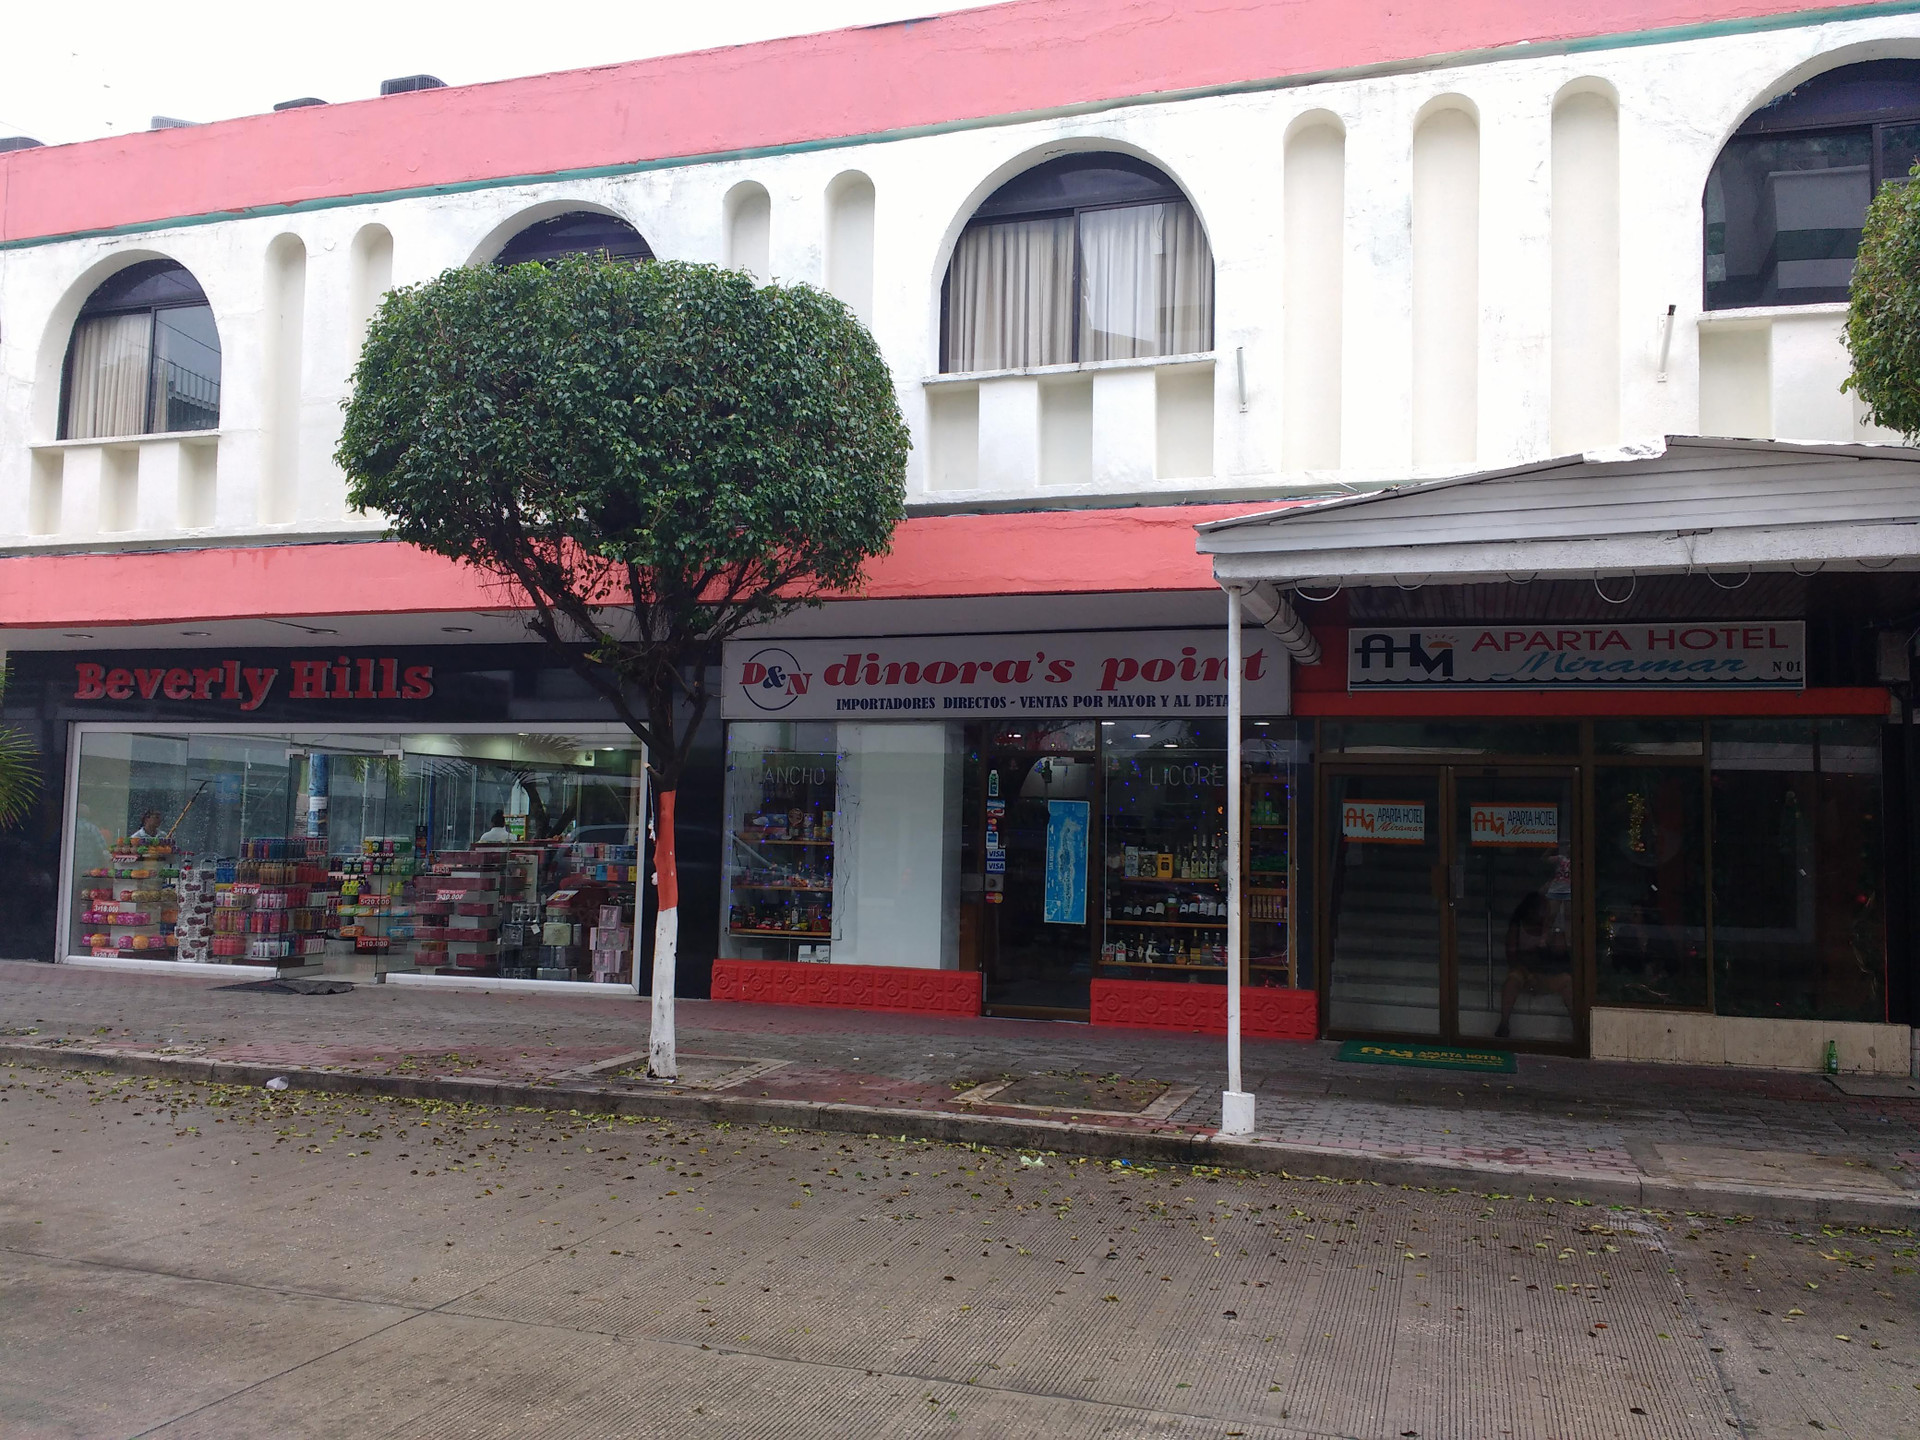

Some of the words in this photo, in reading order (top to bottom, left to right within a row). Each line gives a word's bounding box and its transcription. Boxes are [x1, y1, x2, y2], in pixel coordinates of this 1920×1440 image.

[1472, 630, 1632, 652] APARTA
[1648, 627, 1788, 650] HOTEL
[823, 652, 1076, 686] dinora's
[1096, 646, 1268, 692] point
[1491, 651, 1747, 677] Miramar
[1787, 660, 1801, 673] 01
[75, 660, 279, 711] Beverly
[289, 655, 434, 700] Hills
[739, 662, 813, 695] D&N
[836, 696, 936, 711] IMPORTADORES
[944, 696, 1007, 709] DIRECTOS
[1020, 695, 1068, 709] VENTAS
[1073, 695, 1103, 708] POR
[1108, 694, 1156, 708] MAYOR
[1160, 695, 1169, 707] Y
[1173, 694, 1191, 708] AL
[1195, 694, 1229, 708] DETA
[1150, 765, 1225, 786] LICORE
[1376, 808, 1401, 823] APARTA
[1402, 808, 1424, 823] HOTEL
[1507, 810, 1533, 826] APARTA
[1534, 810, 1557, 826] HOTEL
[1376, 821, 1424, 832] Miramar
[1506, 824, 1557, 836] Miramar
